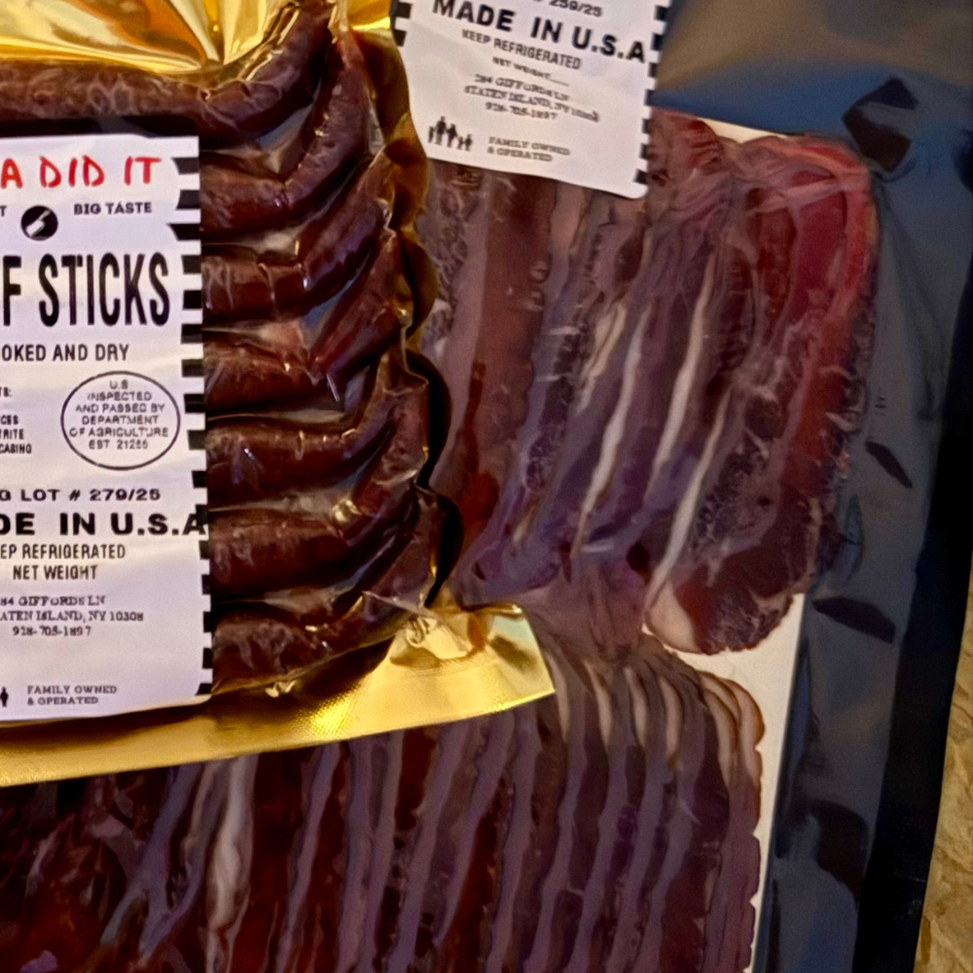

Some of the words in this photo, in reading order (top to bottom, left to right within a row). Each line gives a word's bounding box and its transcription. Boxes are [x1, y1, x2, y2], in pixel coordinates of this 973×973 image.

[531, 17, 562, 43] IN
[572, 26, 645, 63] U.S.A
[462, 29, 490, 45] KEEP
[494, 39, 581, 69] REFRIGERATED
[489, 136, 530, 148] FAMILY
[532, 143, 571, 155] OWNED
[497, 148, 552, 161] OPERATED
[40, 155, 104, 188] DID
[124, 156, 161, 186] IT
[74, 203, 101, 215] BIG
[106, 202, 152, 213] TASTE
[39, 253, 170, 327] STICKS
[53, 344, 88, 361] AND
[95, 344, 129, 361] DRY
[87, 392, 152, 401] INSPECTED
[76, 404, 99, 413] AND
[102, 403, 147, 413] PASSED
[151, 404, 165, 412] BY
[82, 415, 158, 425] DEPARTMENT
[69, 428, 85, 437] OF
[88, 428, 168, 437] AGRICULTURE
[89, 439, 110, 449] EST
[21, 489, 60, 501] LOT
[69, 490, 80, 501] #
[89, 489, 160, 501] 279/25
[60, 513, 95, 535] IN
[111, 513, 206, 535] U.S.A
[22, 544, 126, 559] REFRIGERATED
[13, 565, 41, 580] NET
[44, 565, 98, 580] WEIGHT
[88, 595, 105, 606] LN
[36, 611, 86, 623] ISLAND,
[89, 611, 106, 621] NY
[27, 685, 69, 694] FAMILY
[74, 685, 117, 694] OWNED
